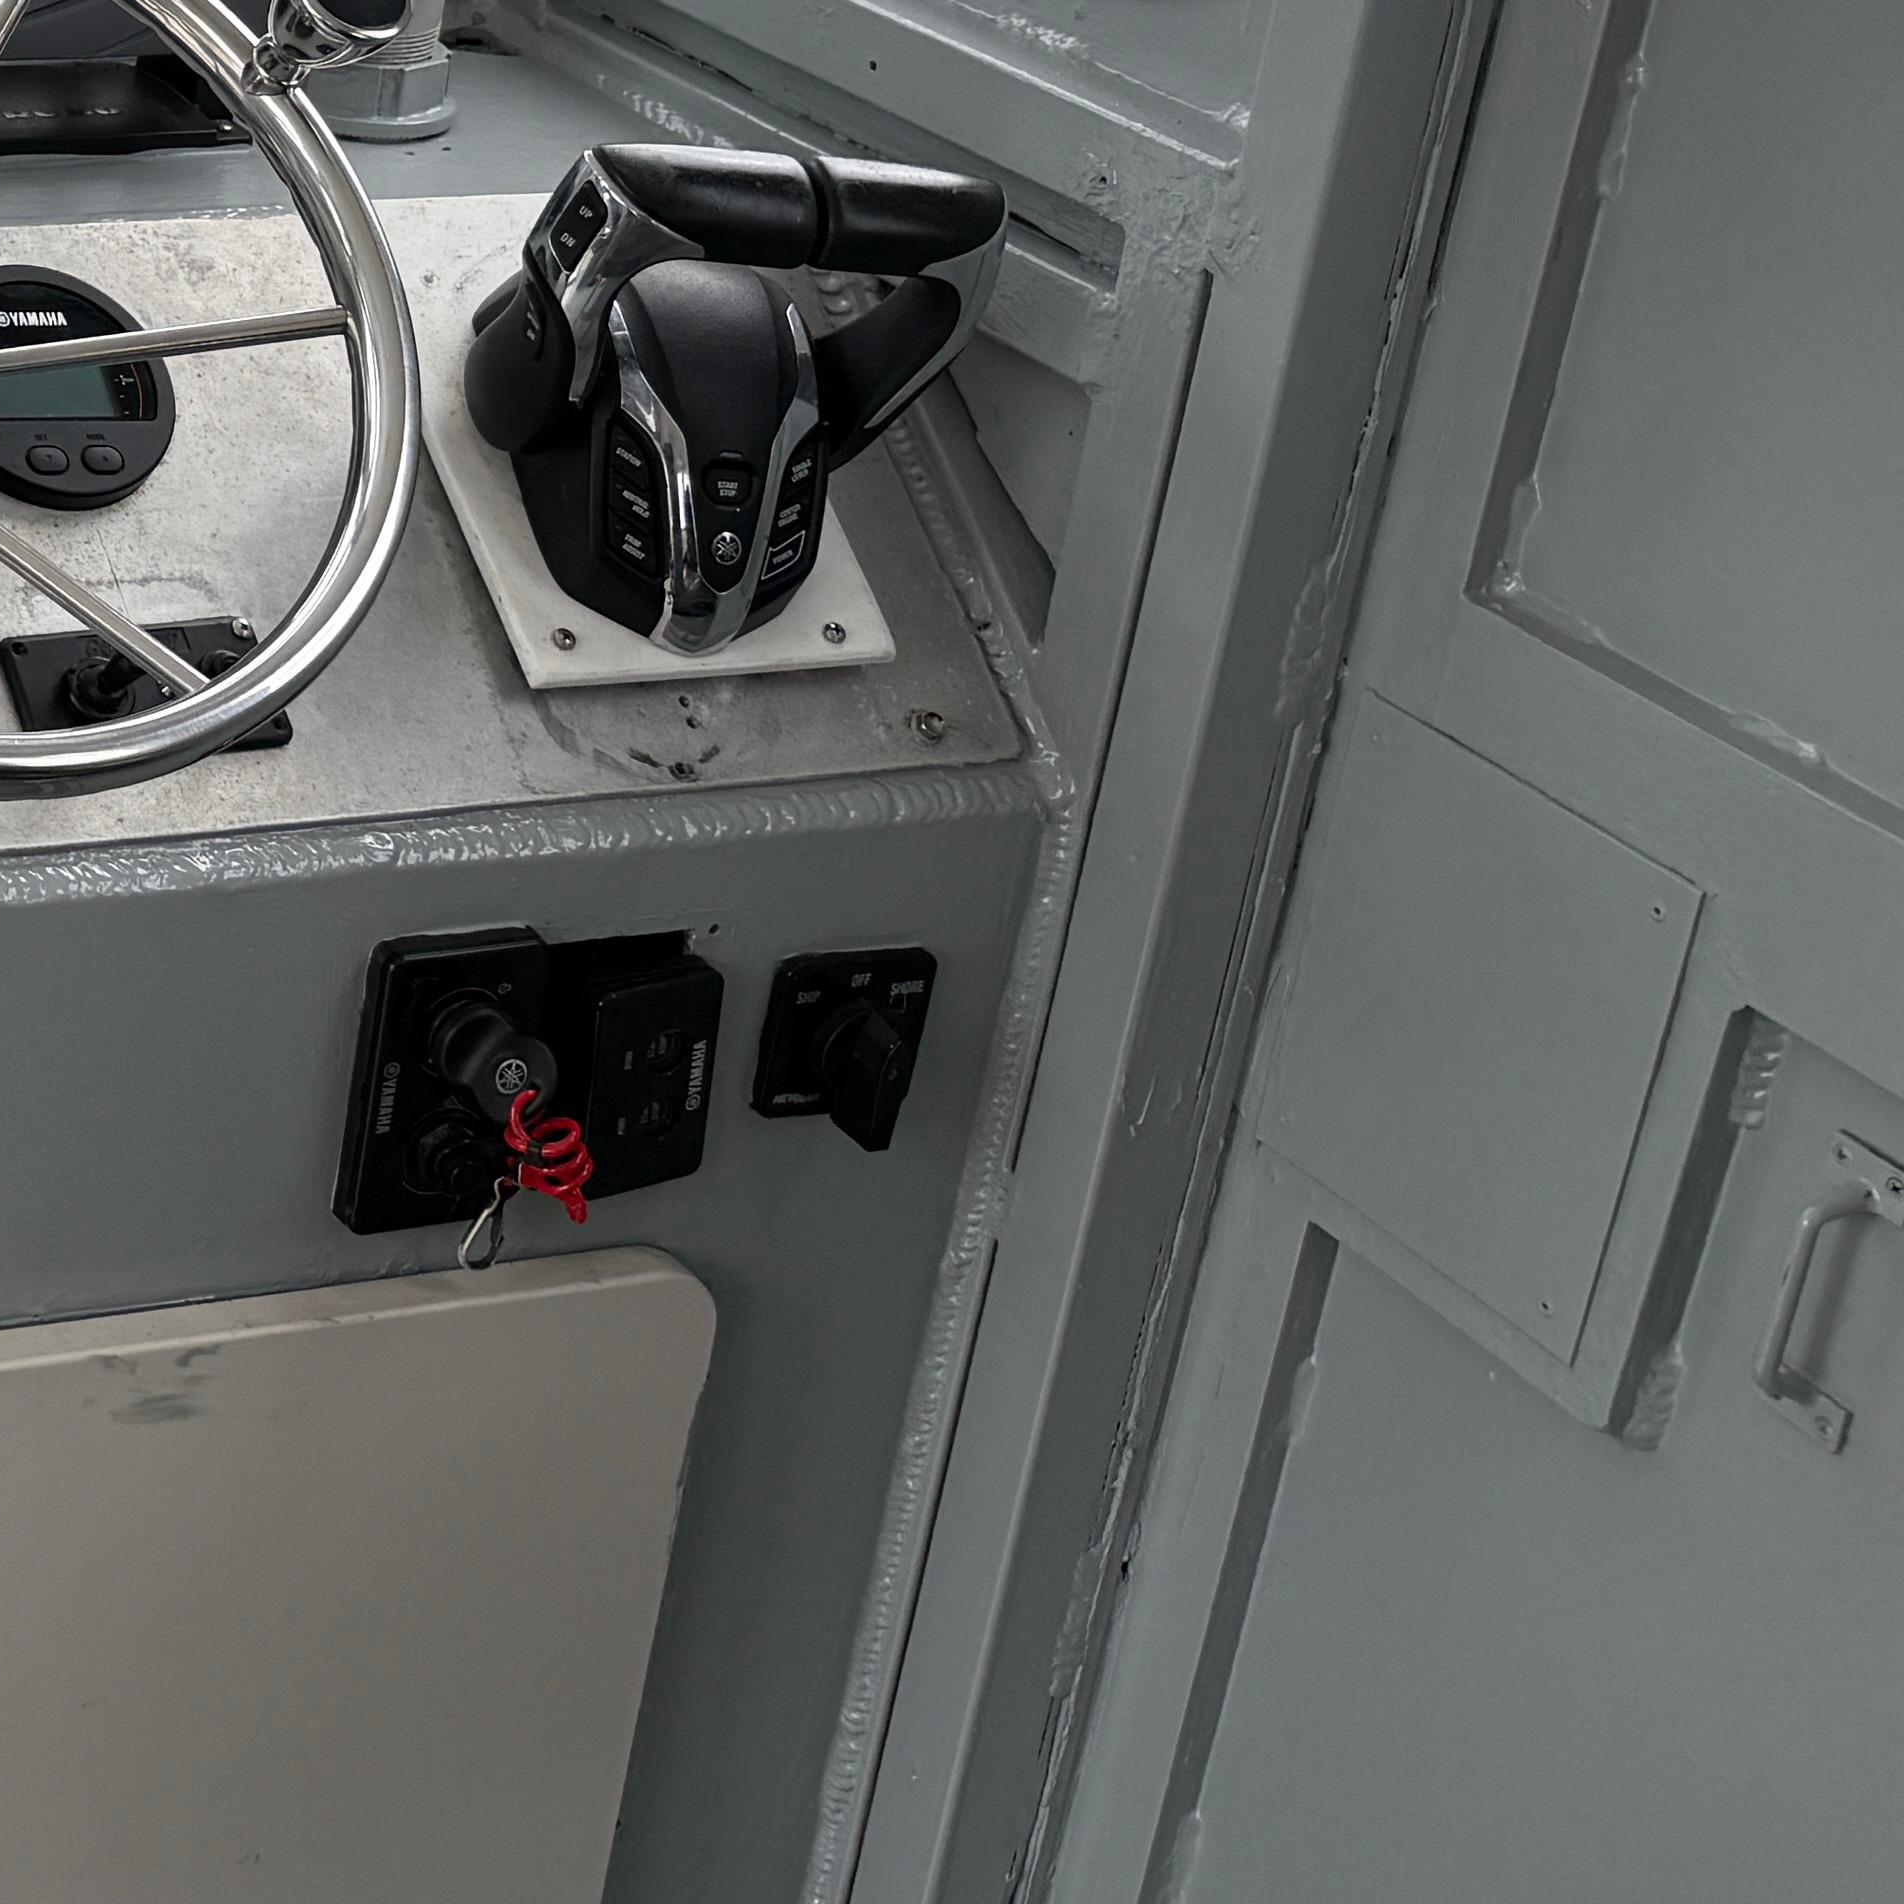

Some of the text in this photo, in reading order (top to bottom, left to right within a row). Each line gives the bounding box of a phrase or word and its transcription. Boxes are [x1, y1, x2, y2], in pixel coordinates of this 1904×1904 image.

[9, 311, 68, 327] YAMAHA
[851, 973, 873, 988] OFF
[687, 1039, 707, 1096] YAMAHA
[376, 1078, 398, 1134] YAMAHA
